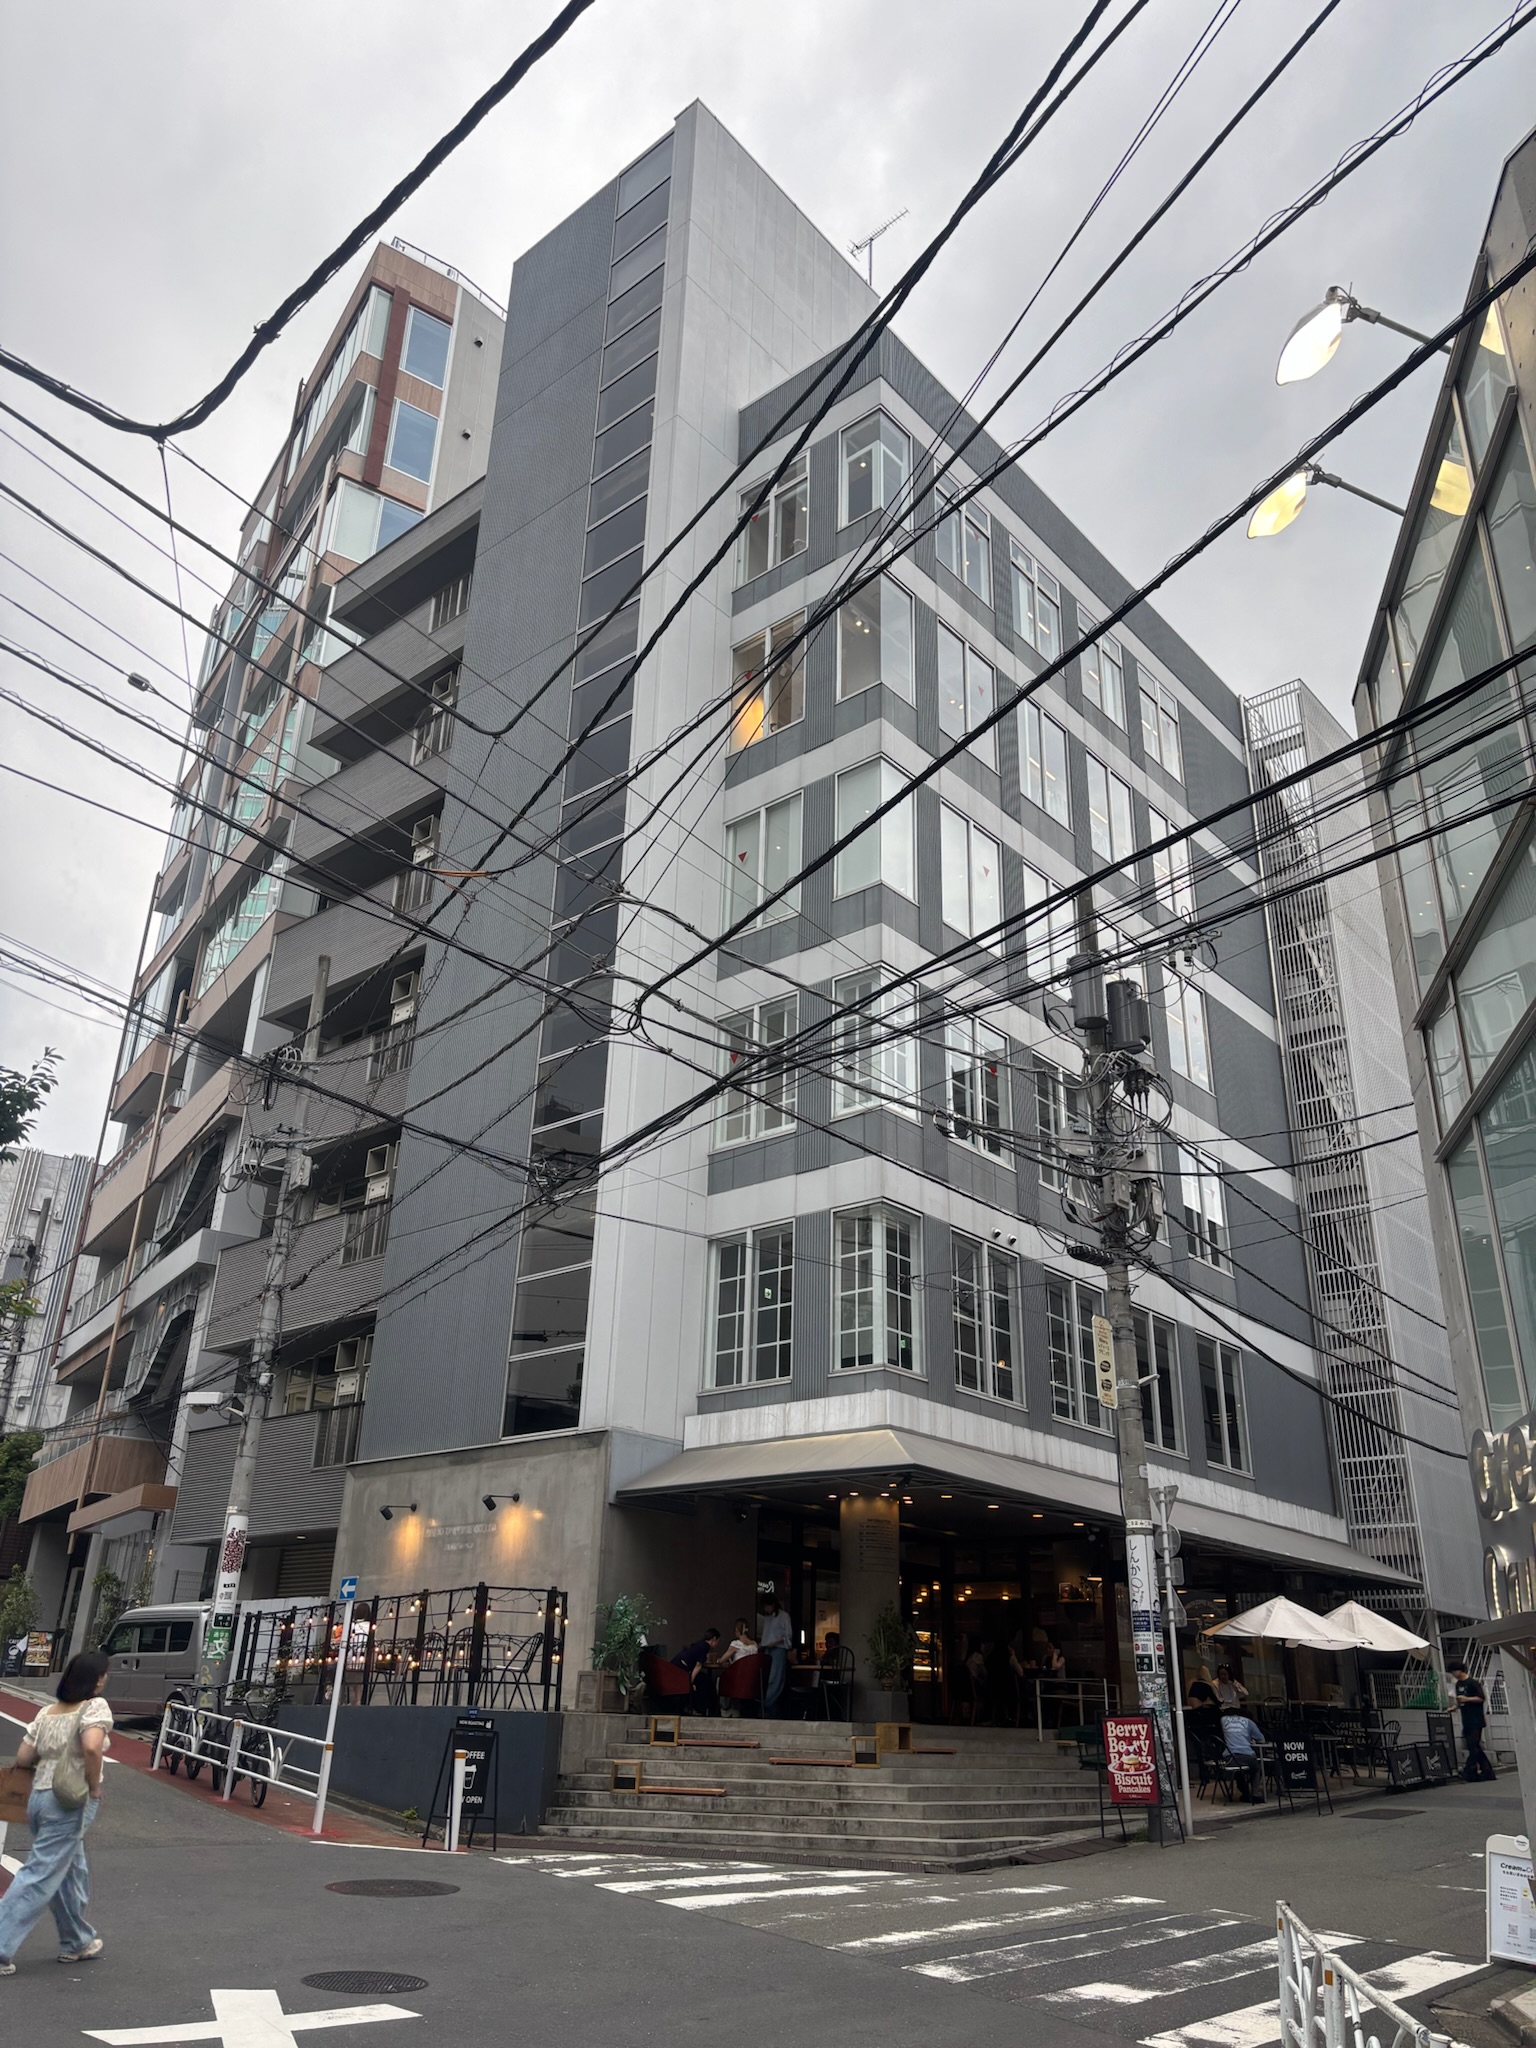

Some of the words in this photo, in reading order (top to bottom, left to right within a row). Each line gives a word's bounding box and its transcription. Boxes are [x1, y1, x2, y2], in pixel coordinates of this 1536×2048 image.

[1471, 1425, 1536, 1521] Cre
[207, 1638, 227, 1656] 文
[1106, 1721, 1148, 1740] Berry
[1108, 1737, 1150, 1756] Bery
[1283, 1742, 1305, 1751] NOW
[466, 1751, 485, 1760] OFFEE
[1285, 1753, 1308, 1762] OPEN
[1114, 1773, 1153, 1786] Biscuit
[1118, 1785, 1151, 1794] Pancakes
[466, 1796, 483, 1804] OPEN
